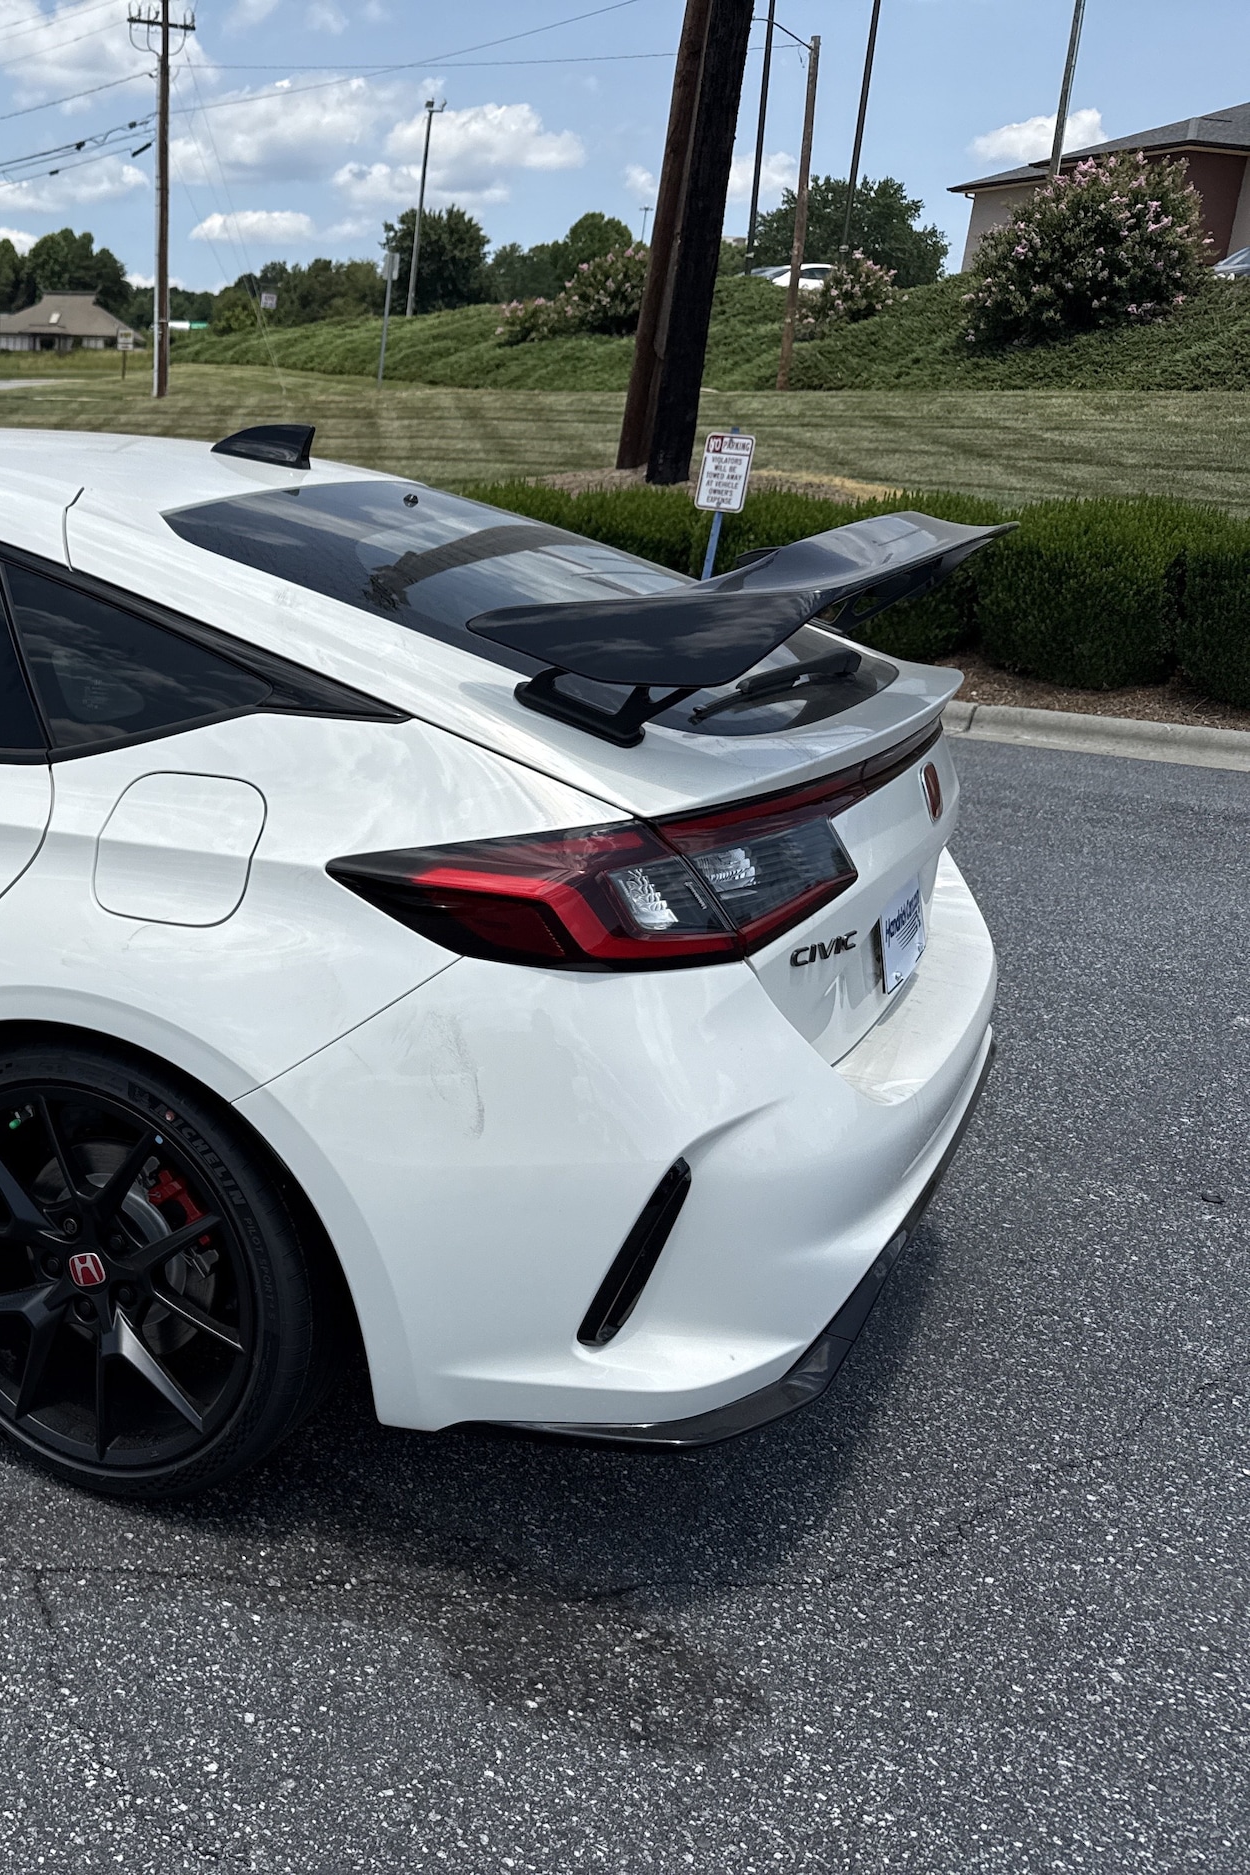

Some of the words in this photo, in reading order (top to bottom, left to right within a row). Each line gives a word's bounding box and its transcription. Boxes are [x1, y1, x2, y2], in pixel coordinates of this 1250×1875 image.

[709, 438, 721, 452] NO
[723, 440, 751, 452] PARKING
[712, 457, 743, 466] VIOLATORS
[706, 472, 725, 480] TOWED
[715, 481, 739, 489] VEHICLE
[706, 496, 733, 505] EXPENSE
[790, 930, 857, 967] CIVIC
[154, 1105, 246, 1207] MICHELIN
[243, 1217, 264, 1254] PILOT
[258, 1258, 275, 1300] SPORT
